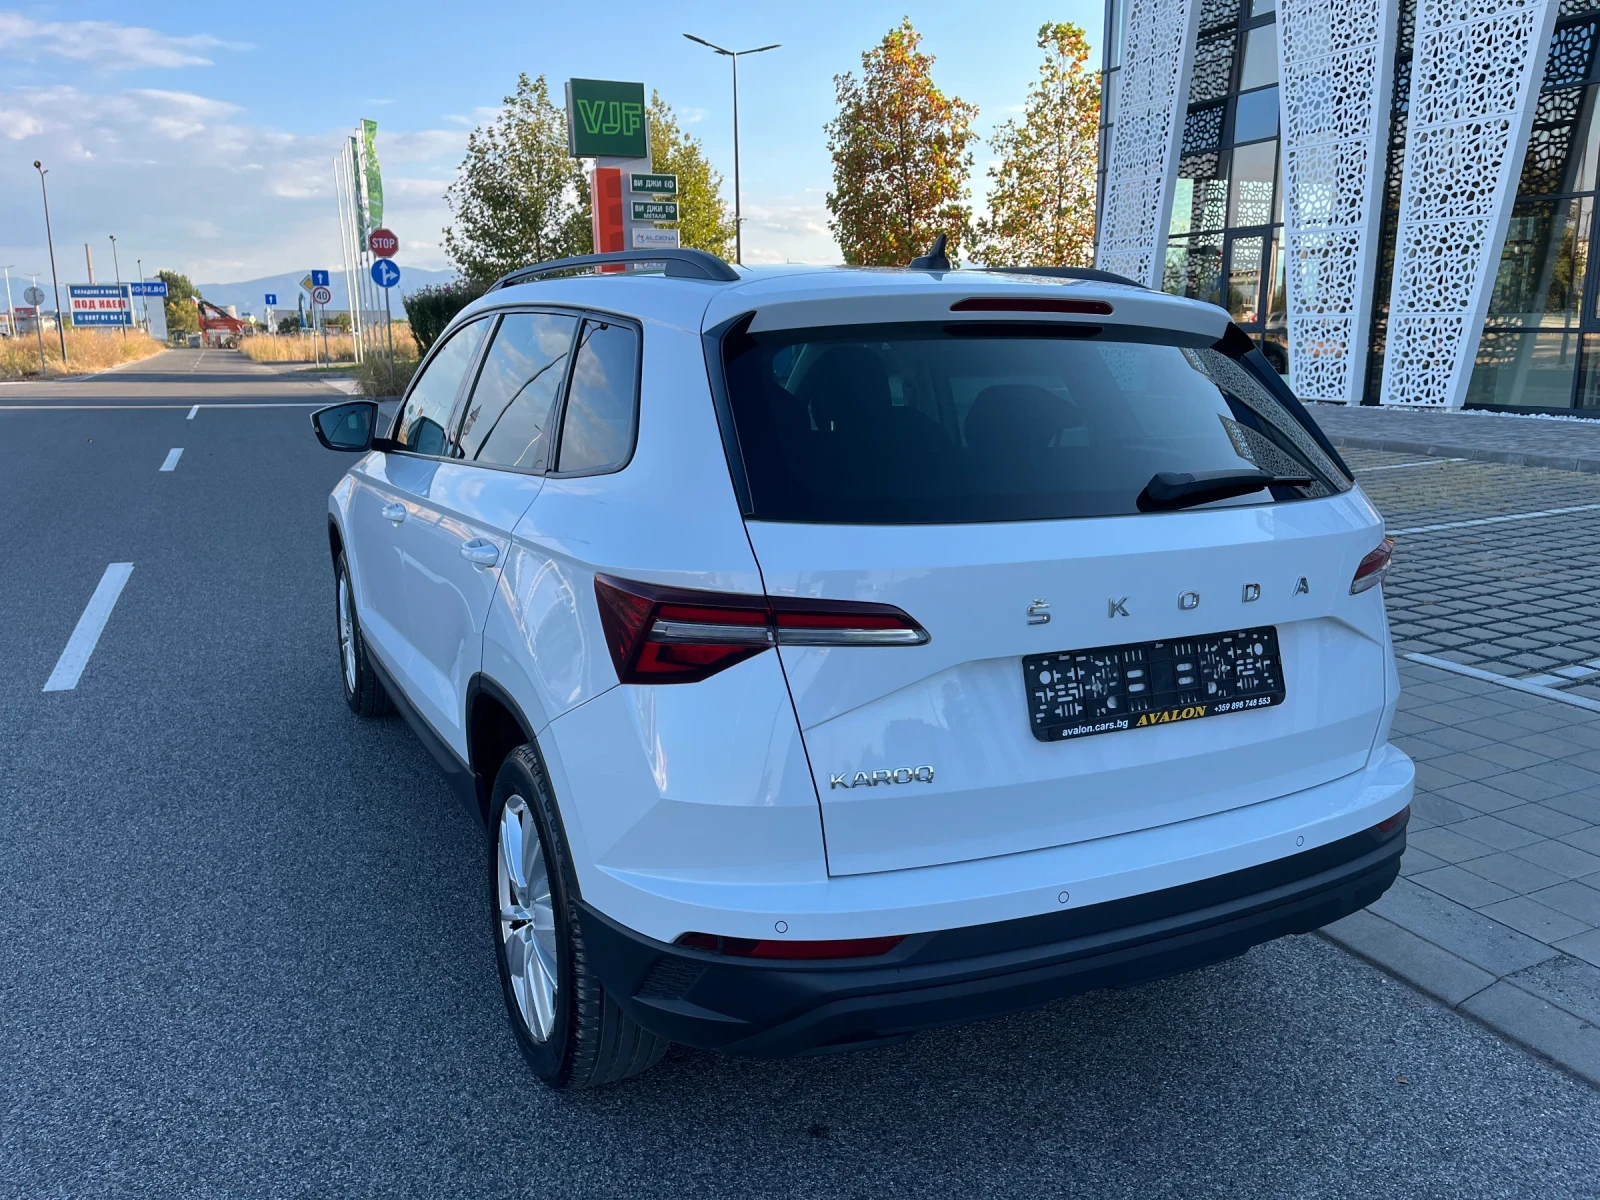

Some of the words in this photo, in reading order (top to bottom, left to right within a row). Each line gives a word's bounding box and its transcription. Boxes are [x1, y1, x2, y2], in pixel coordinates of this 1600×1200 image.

[577, 99, 642, 135] VJF
[633, 179, 643, 187] ВИ
[645, 179, 662, 188] ДЖИ
[664, 180, 674, 189] ЕФ
[646, 205, 663, 213] ДЖИ
[665, 205, 675, 214] ЕФ
[372, 238, 395, 249] STOP
[316, 291, 328, 300] 40
[74, 300, 96, 310] ПОД
[1027, 576, 1310, 625] ŠKODA
[1062, 718, 1128, 737] avalon.cars.bg
[1136, 705, 1207, 727] AVALON
[1214, 703, 1231, 712] +359
[1231, 700, 1244, 710] 898
[1245, 698, 1257, 708] 748
[1258, 696, 1271, 705] 553
[829, 764, 935, 790] KAROQ
